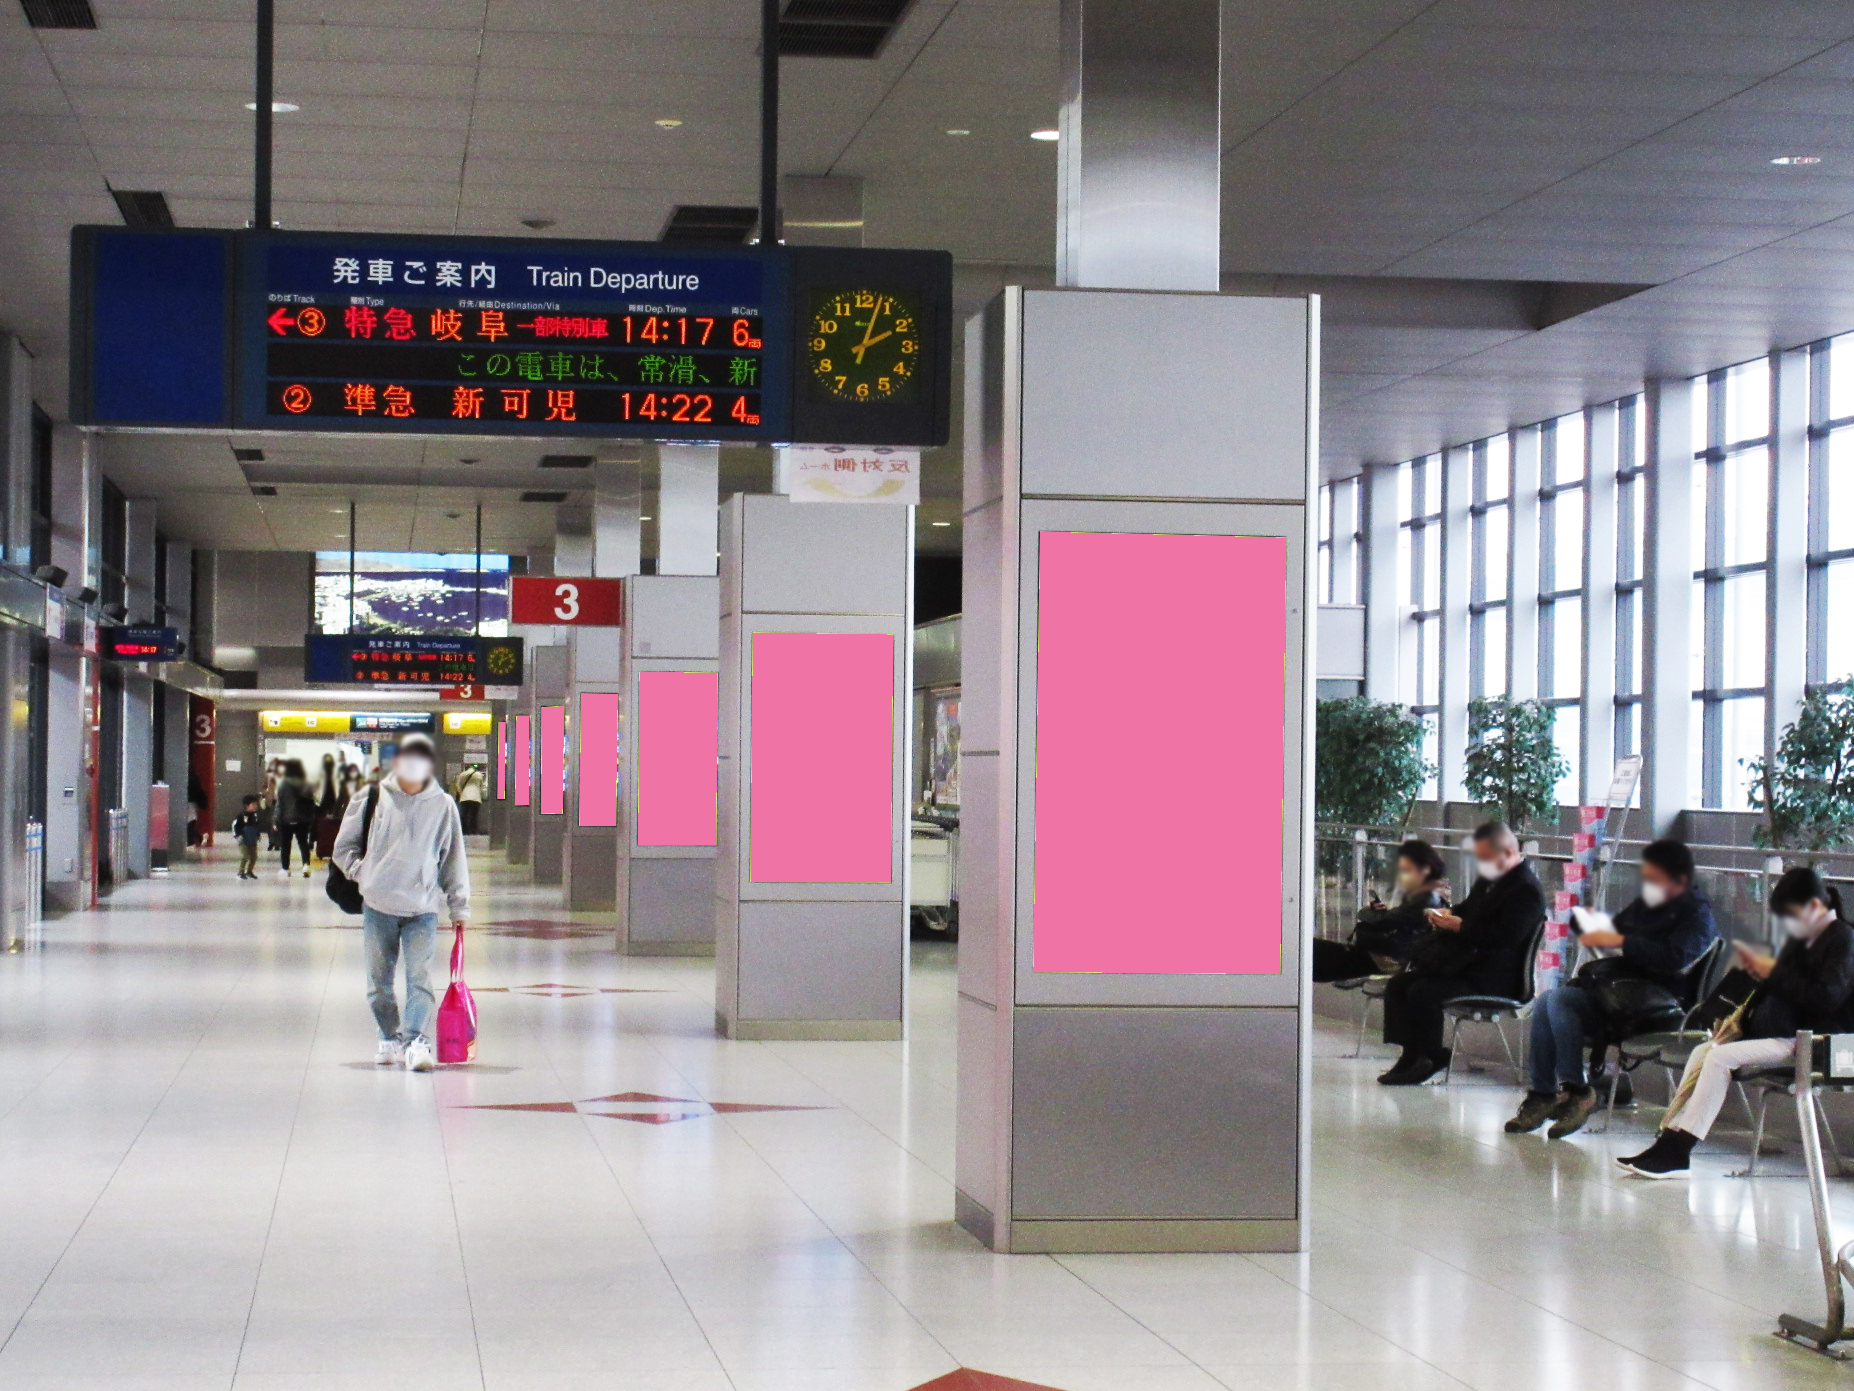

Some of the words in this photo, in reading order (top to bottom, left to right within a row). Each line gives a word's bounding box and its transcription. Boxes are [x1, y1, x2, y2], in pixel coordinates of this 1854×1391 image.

[333, 257, 496, 289] 発車ご案内
[527, 266, 582, 287] Train
[590, 267, 700, 294] Departure
[293, 295, 315, 304] Track
[366, 297, 384, 306] Type
[854, 294, 874, 308] 12
[740, 307, 758, 316] Cars
[834, 302, 851, 316] 11
[883, 302, 891, 315] 1
[344, 306, 416, 340] 特急
[431, 308, 509, 343] 岐阜
[623, 316, 714, 345] 14:17
[819, 320, 838, 334] 10
[895, 319, 908, 332] 2
[813, 337, 826, 351] 9
[901, 340, 914, 353] 3
[819, 359, 832, 372] 8
[893, 362, 906, 375] 4
[835, 376, 847, 389] 7
[878, 377, 891, 390] 5
[856, 383, 869, 397] 6
[344, 384, 415, 417] 準急
[452, 386, 577, 422] 新可児
[622, 393, 712, 423] 14:22
[554, 583, 580, 621] 3
[195, 714, 212, 738] 3
